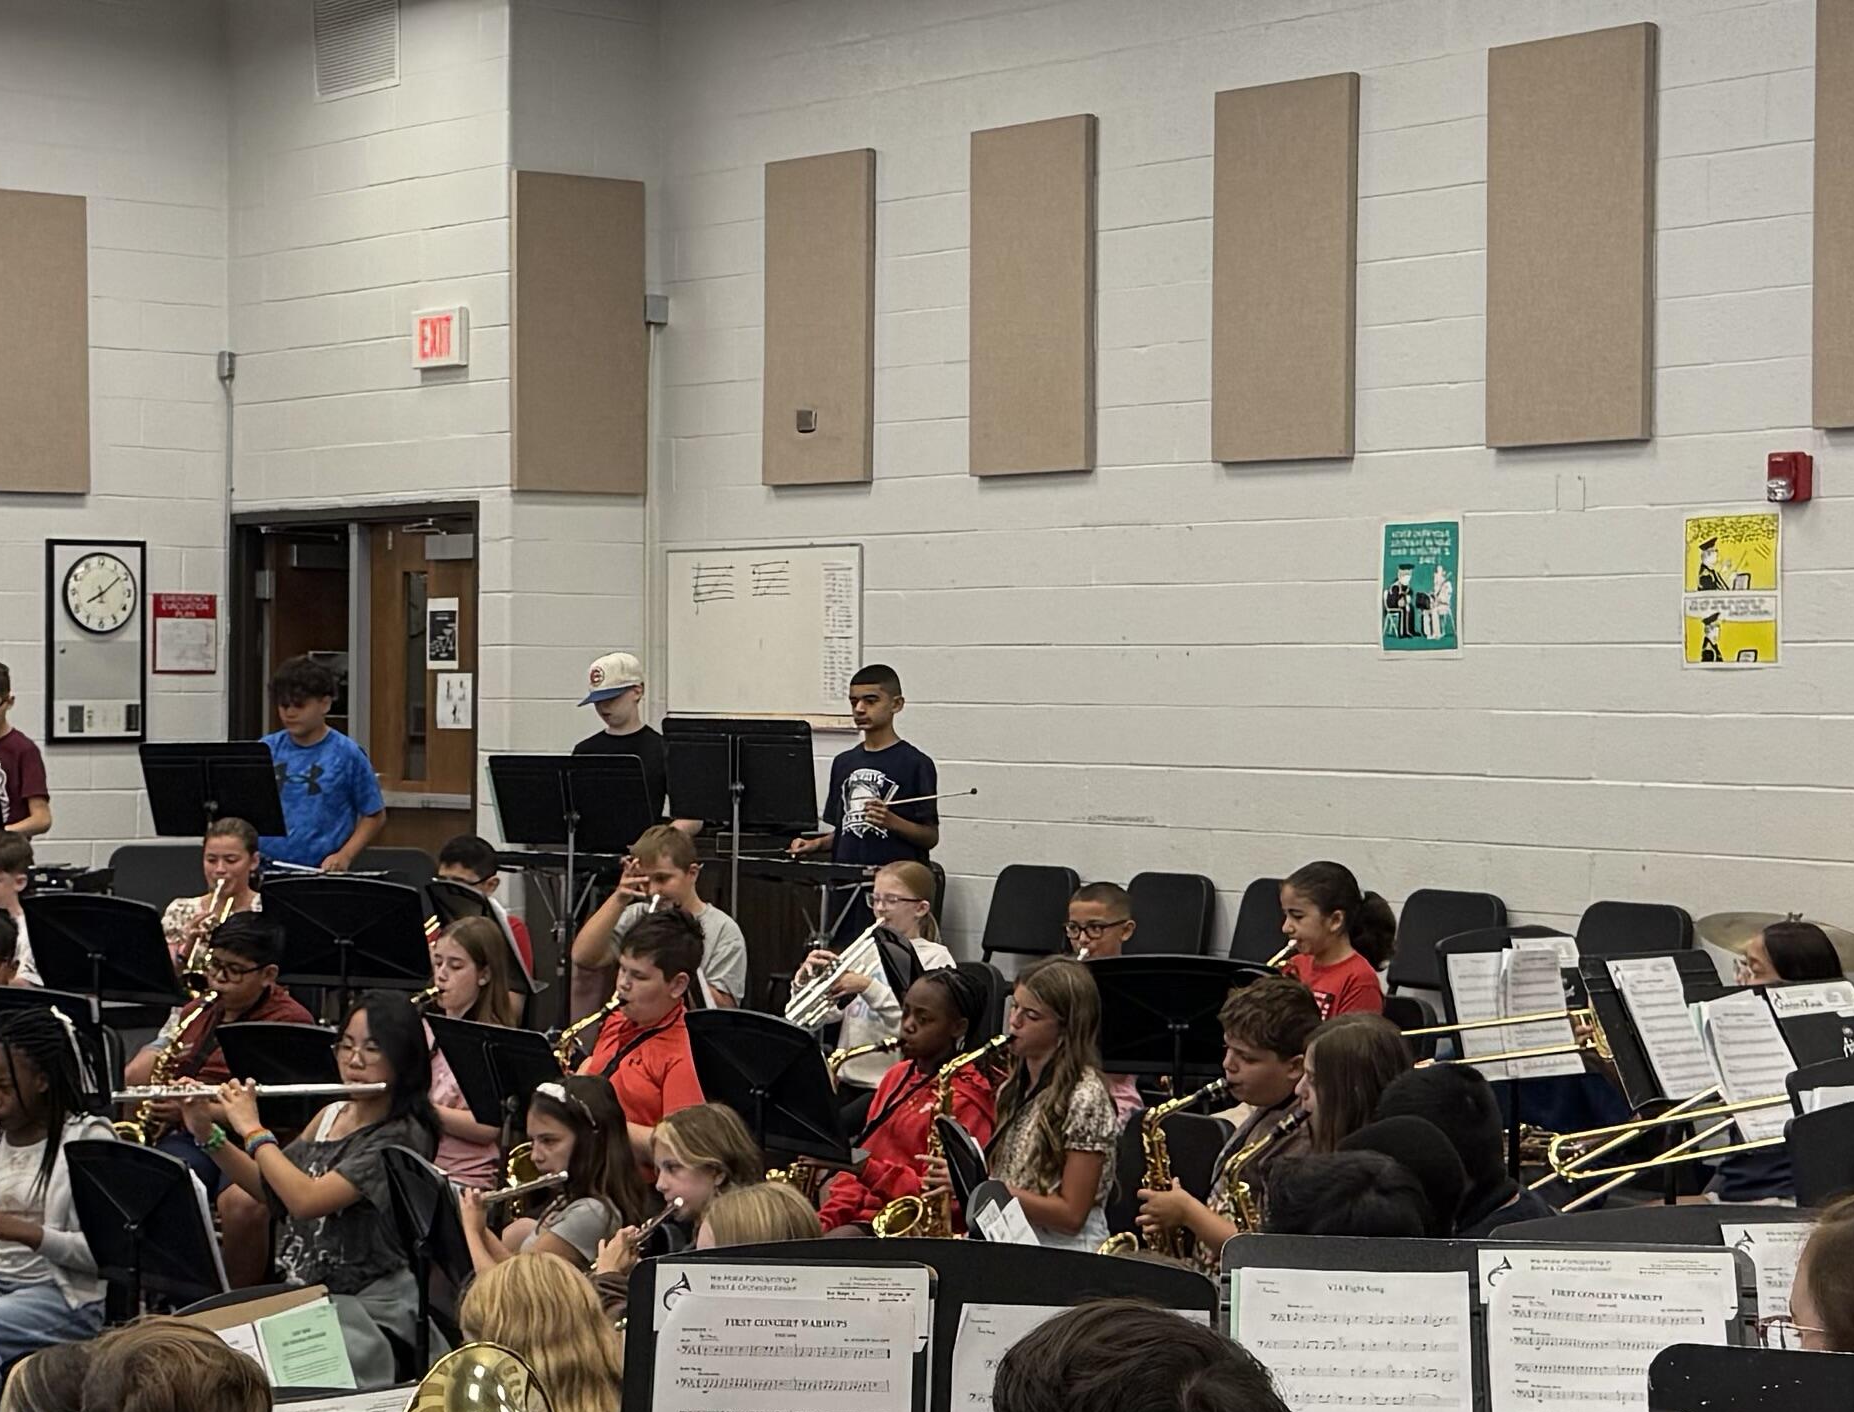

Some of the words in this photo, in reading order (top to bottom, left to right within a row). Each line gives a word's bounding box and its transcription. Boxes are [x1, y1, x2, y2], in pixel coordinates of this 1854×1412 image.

[418, 316, 451, 359] EXIT
[1551, 1289, 1575, 1298] FIRST
[1578, 1291, 1617, 1300] CONCERT
[725, 1318, 751, 1328] FIRST
[754, 1319, 798, 1328] CONCERT
[801, 1319, 848, 1328] WARMUPS
